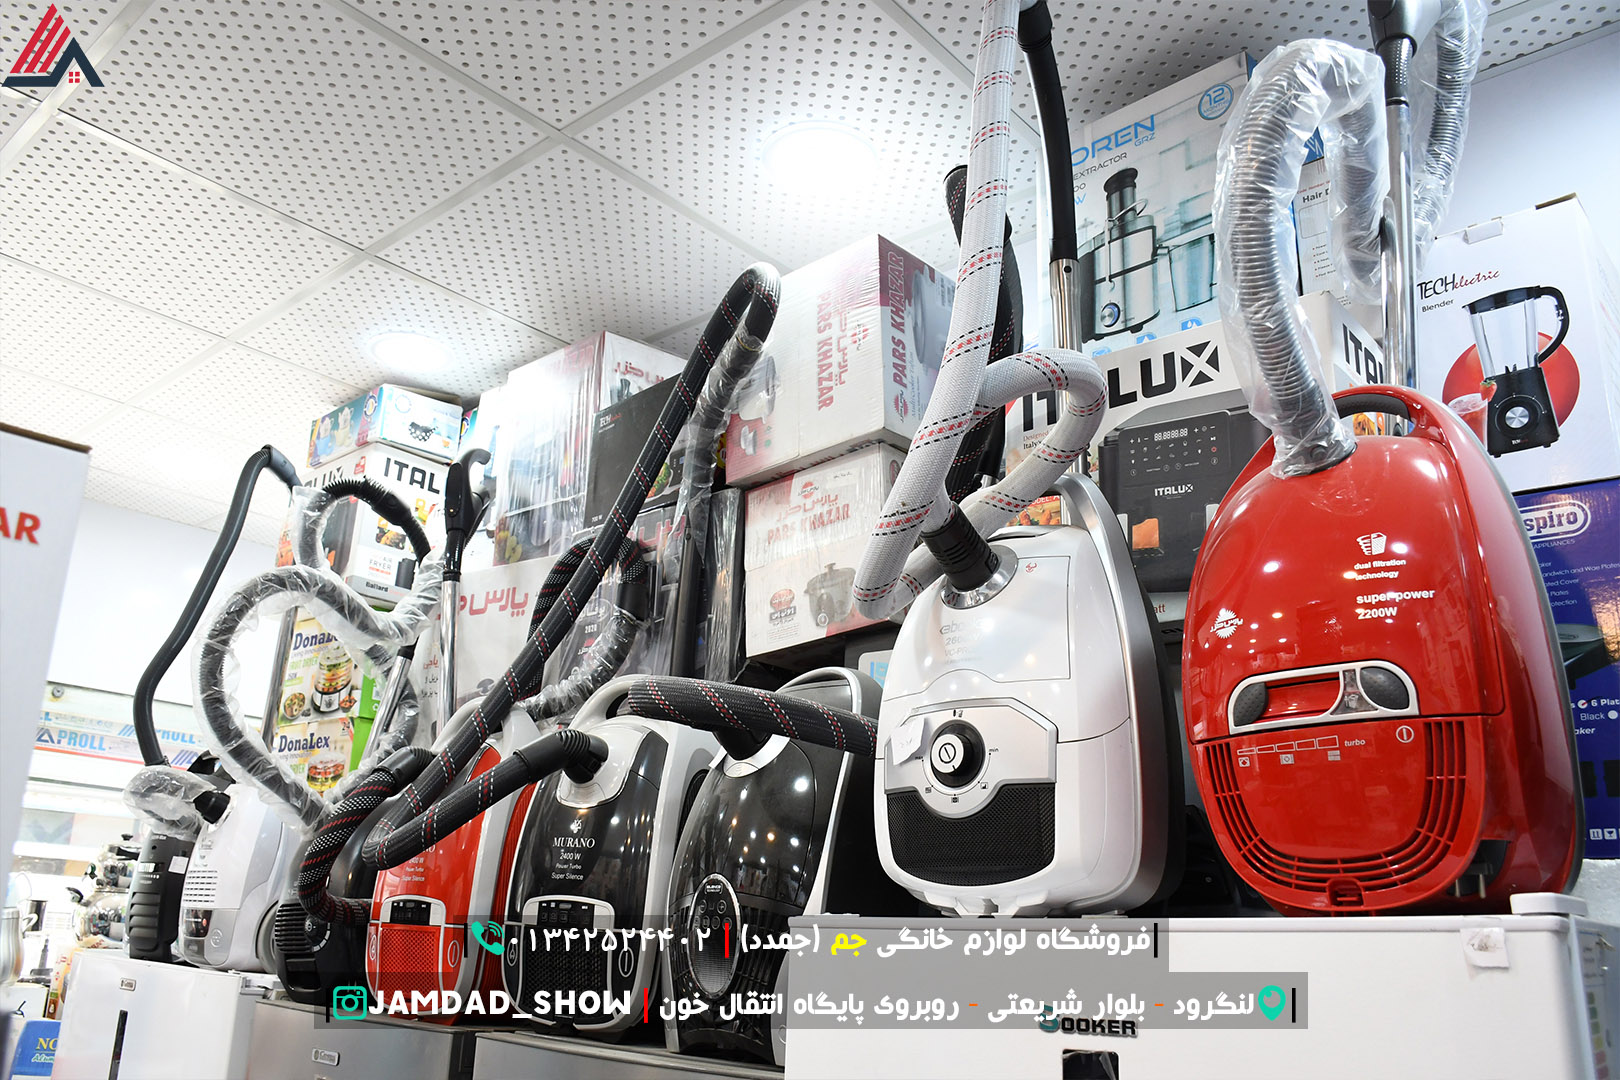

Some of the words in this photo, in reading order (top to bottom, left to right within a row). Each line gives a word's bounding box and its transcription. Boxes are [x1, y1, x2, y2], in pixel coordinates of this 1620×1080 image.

[1206, 87, 1225, 106] 12
[1073, 152, 1127, 180] EXTRACTOR
[1302, 192, 1322, 203] Hair
[887, 251, 907, 334] KHAZAR
[1421, 299, 1454, 313] Blender
[891, 335, 907, 389] PARS
[817, 336, 835, 411] KHAZAR
[1022, 340, 1221, 432] ITLUX
[1023, 431, 1050, 441] Designed
[384, 457, 441, 494] ITAL
[1154, 484, 1194, 497] ITALUX
[767, 522, 797, 545] PARS
[800, 503, 852, 533] KHAZAR
[1523, 511, 1578, 534] spiro
[1533, 539, 1576, 549] APPLIANCES
[1353, 562, 1371, 570] dual
[1372, 559, 1407, 569] filtration
[1570, 566, 1584, 574] and
[469, 586, 529, 617] پارس
[1357, 606, 1398, 620] 2200W
[1580, 712, 1605, 720] Black
[278, 732, 331, 753] DonaLex
[1344, 739, 1366, 747] turbo
[553, 837, 596, 848] MURANO
[574, 852, 582, 860] W
[551, 871, 565, 880] Super
[565, 872, 584, 880] Silence
